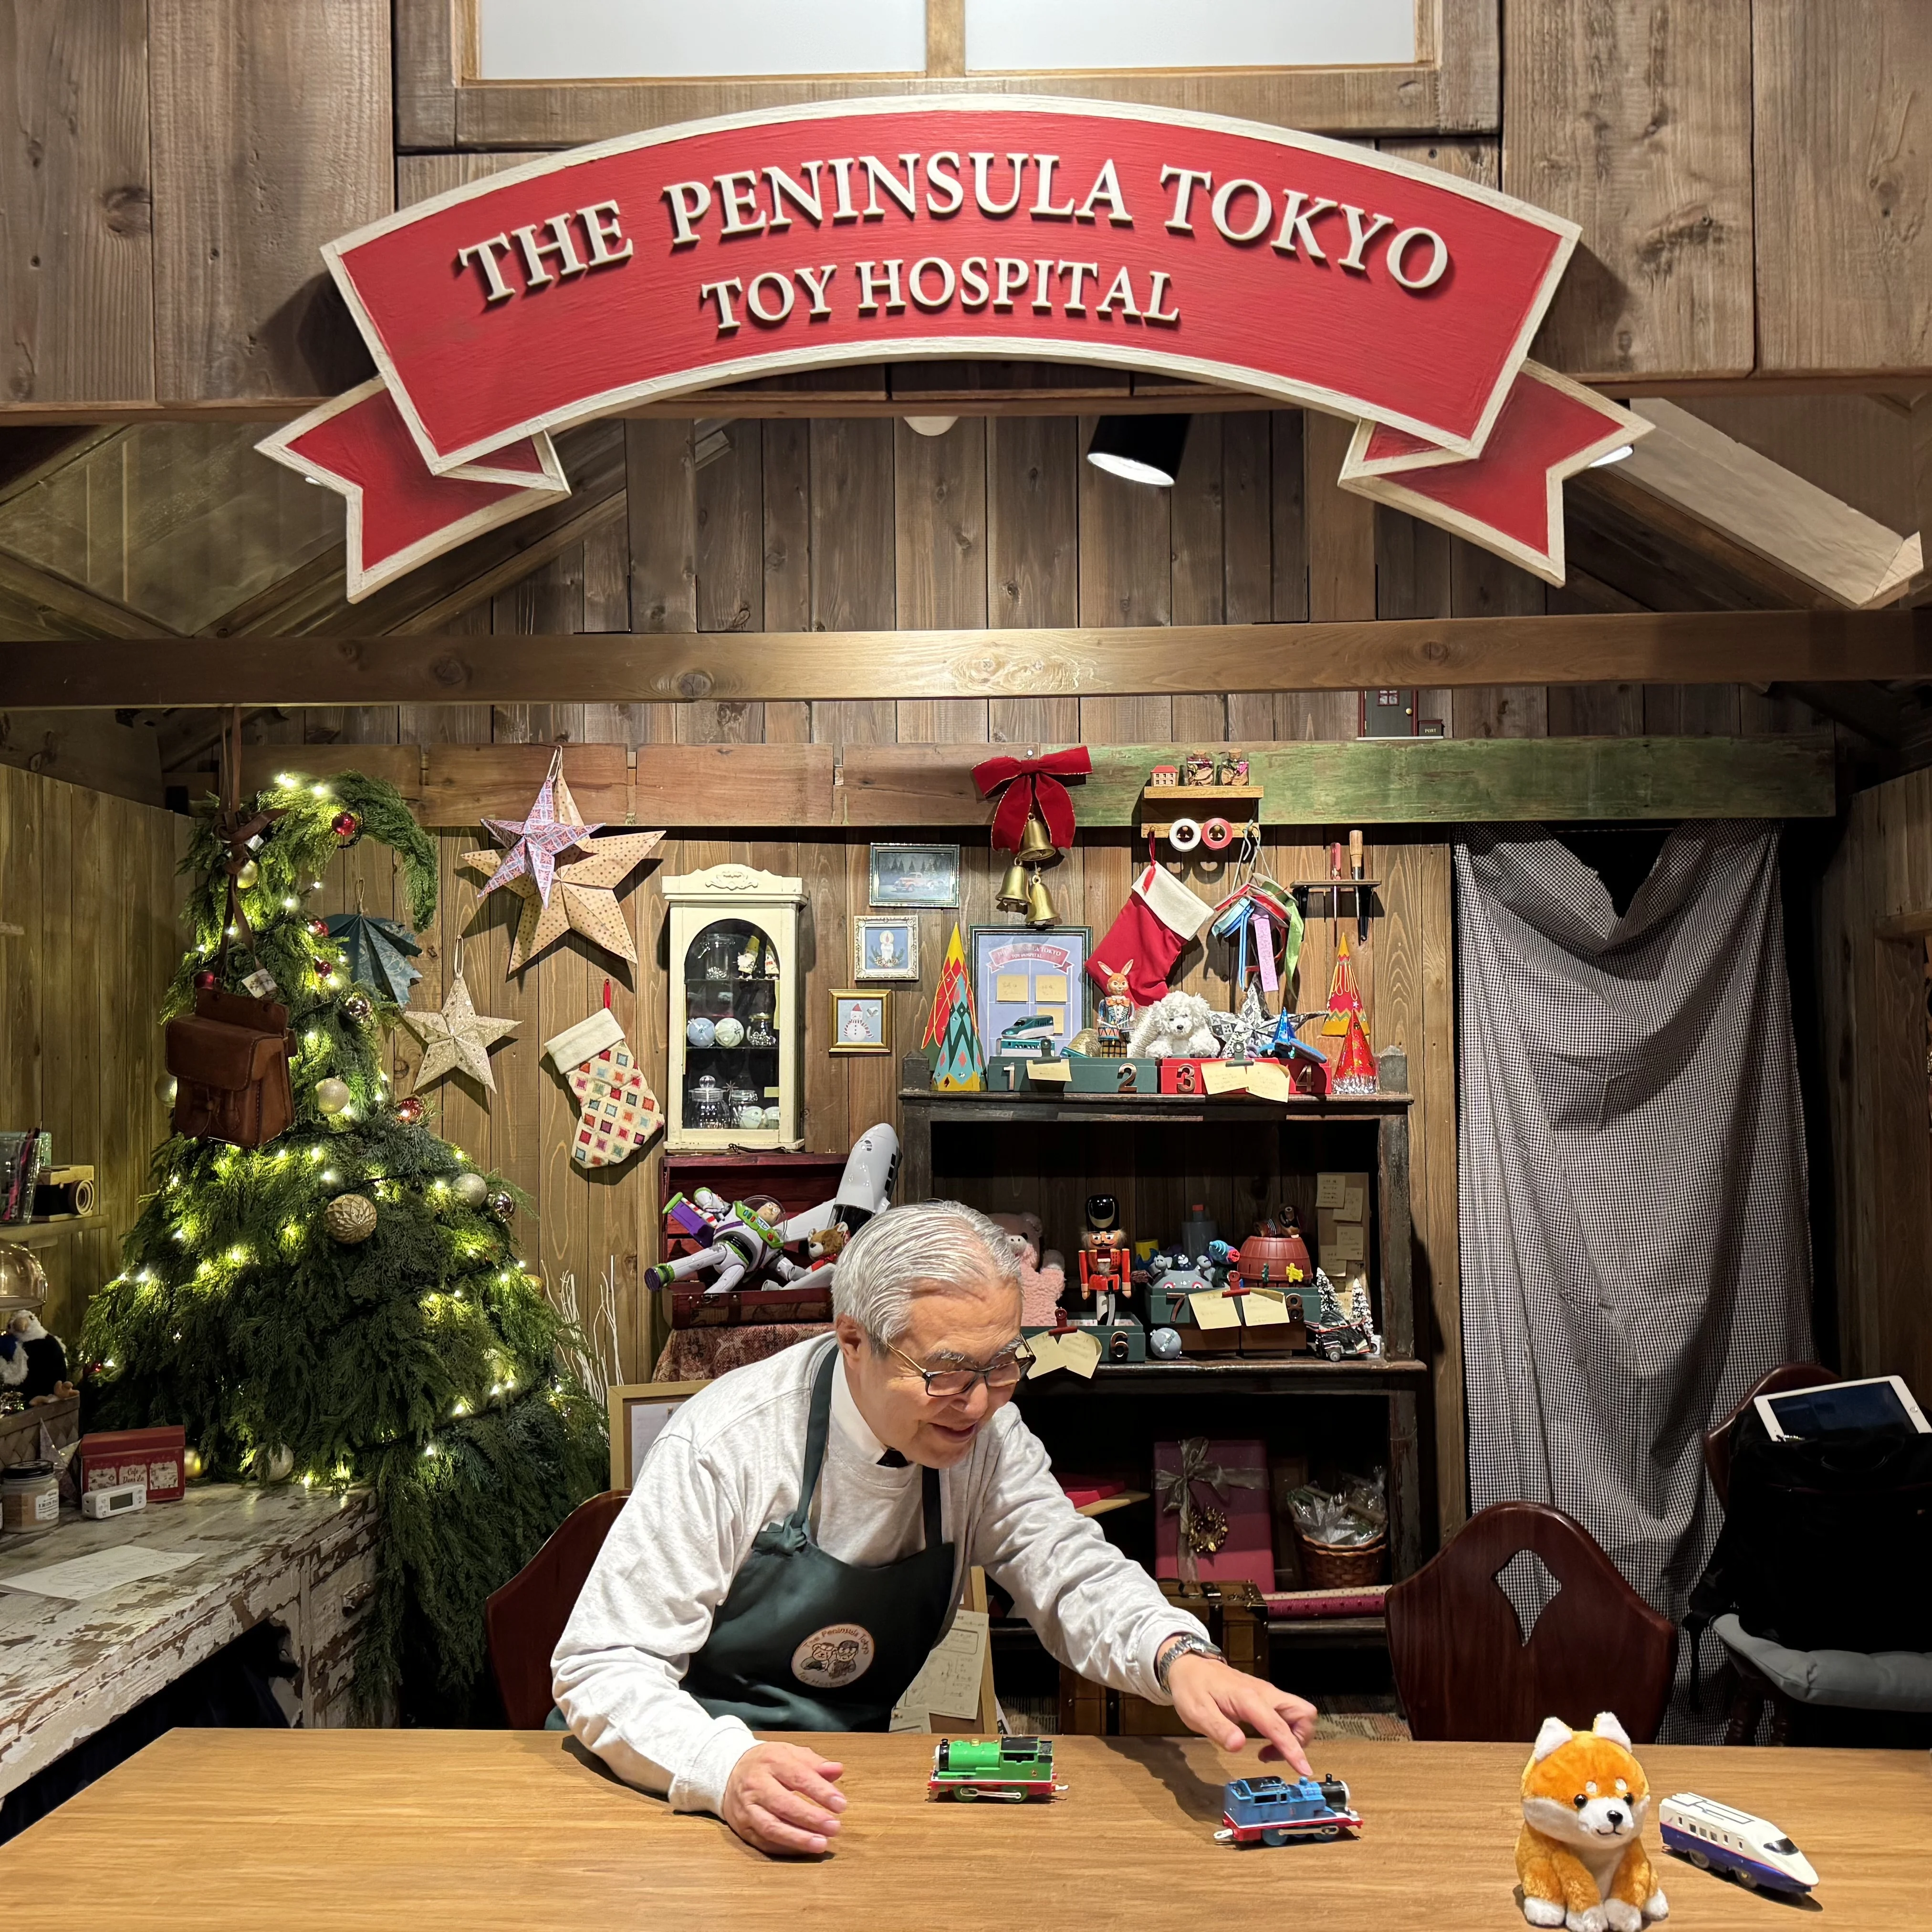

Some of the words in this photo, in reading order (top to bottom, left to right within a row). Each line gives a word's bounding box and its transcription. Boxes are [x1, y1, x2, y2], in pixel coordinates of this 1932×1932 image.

[457, 198, 634, 301] THE
[662, 149, 1134, 244] PENINSULA
[1159, 163, 1448, 289] TOKYO
[700, 263, 839, 329] TOY
[854, 255, 1180, 322] HOSPITAL
[1041, 947, 1061, 956] TOKYO
[1003, 1062, 1015, 1091] 1
[1118, 1063, 1138, 1093] 2
[1177, 1063, 1195, 1092] 3
[1296, 1065, 1315, 1092] 4
[1166, 1293, 1186, 1322] 7
[1285, 1294, 1304, 1322] 8
[1110, 1331, 1128, 1358] 6
[858, 1634, 869, 1655] Tokyo
[811, 1678, 849, 1687] Hosp
